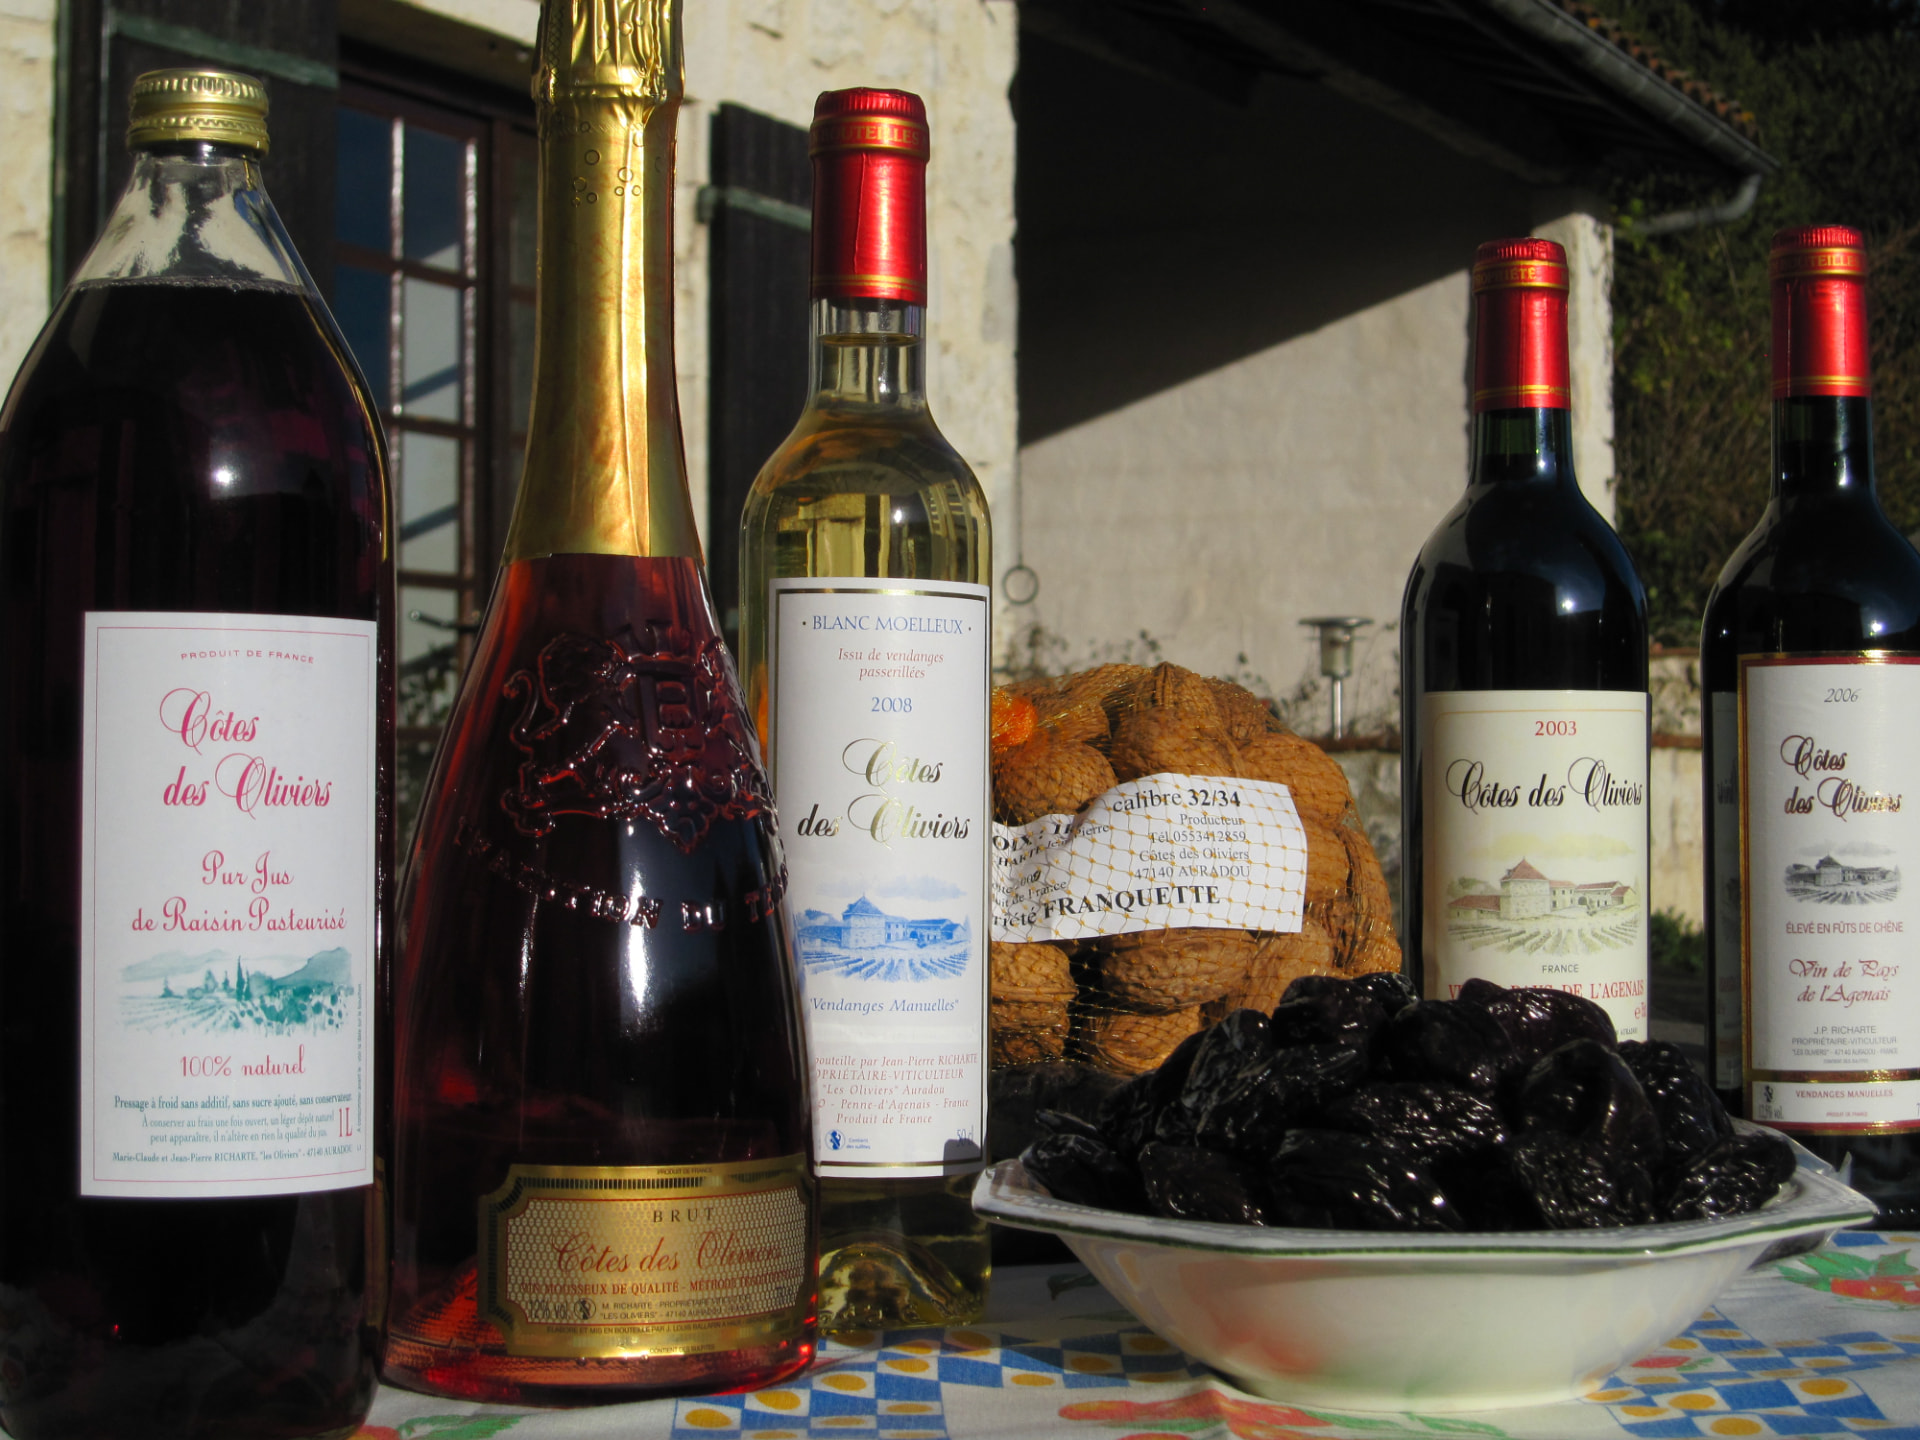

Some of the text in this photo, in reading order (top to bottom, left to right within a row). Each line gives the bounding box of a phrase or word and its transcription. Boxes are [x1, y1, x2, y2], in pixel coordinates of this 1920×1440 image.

[812, 615, 963, 634] BLANC MOELLEUX
[181, 650, 315, 663] PRODUIT DE FRANCE
[838, 648, 944, 667] Issu de vendanges
[1824, 688, 1862, 702] 2006
[871, 697, 913, 713] 2008
[160, 688, 260, 755] Côtes
[1535, 721, 1578, 736] 2003
[1781, 735, 1848, 781] Côtes
[163, 753, 333, 820] des Oliviers
[1445, 757, 1644, 815] Côtes des Oliviers
[1113, 789, 1242, 812] calibre 32/34
[1785, 777, 1903, 822] des Oliviers
[797, 794, 970, 849] des Oliviers
[1180, 814, 1243, 826] Producteur
[1140, 848, 1250, 863] Côtes des Oliviers
[202, 850, 295, 894] Pur Jus
[1134, 866, 1250, 880] 47140 AURADOU
[1043, 885, 1221, 919] FRANQUETTE
[132, 896, 347, 932] de Raisin Pasteurisé
[1786, 920, 1904, 934] ÉLEVÉ EN FÛTS DE CHÊNE
[1542, 964, 1580, 974] FRANCE
[1789, 958, 1900, 981] Vin de Pays
[1590, 979, 1646, 1000] L'AGENAIS
[1797, 983, 1891, 1008] de l'Agenais
[1831, 1025, 1877, 1035] RICHARTE
[181, 1044, 305, 1078] 100% naturel
[861, 1057, 877, 1070] par
[881, 1055, 935, 1068] Jean-Pierre
[937, 1053, 979, 1066] RICHARTE
[902, 1083, 945, 1096] Auradou
[1795, 1089, 1894, 1099] VENDANGES MANUELLES
[114, 1095, 150, 1112] Pressage
[151, 1097, 157, 1109] à
[158, 1096, 179, 1109] froid
[181, 1099, 199, 1109] sans
[201, 1095, 231, 1110] additif,
[232, 1098, 250, 1108] sans
[251, 1097, 271, 1108] sucre
[274, 1094, 298, 1109] ajouté,
[299, 1096, 314, 1106] sans
[943, 1097, 969, 1109] France
[150, 1118, 185, 1128] conserver
[186, 1119, 196, 1128] au
[198, 1115, 213, 1128] frais
[215, 1119, 228, 1127] une
[230, 1115, 244, 1127] fois
[836, 1112, 933, 1124] Produit de France
[150, 1133, 167, 1146] peut
[113, 1151, 160, 1163] Marie-Claude
[161, 1154, 168, 1162] et
[171, 1152, 212, 1163] Jean-Pierre
[653, 1207, 714, 1222] BRUT
[551, 1230, 629, 1273] Côtes
[640, 1236, 678, 1272] des
[546, 1282, 608, 1296] MOUSSEUX
[612, 1283, 628, 1295] DE
[613, 1301, 653, 1311] RICHARTE
